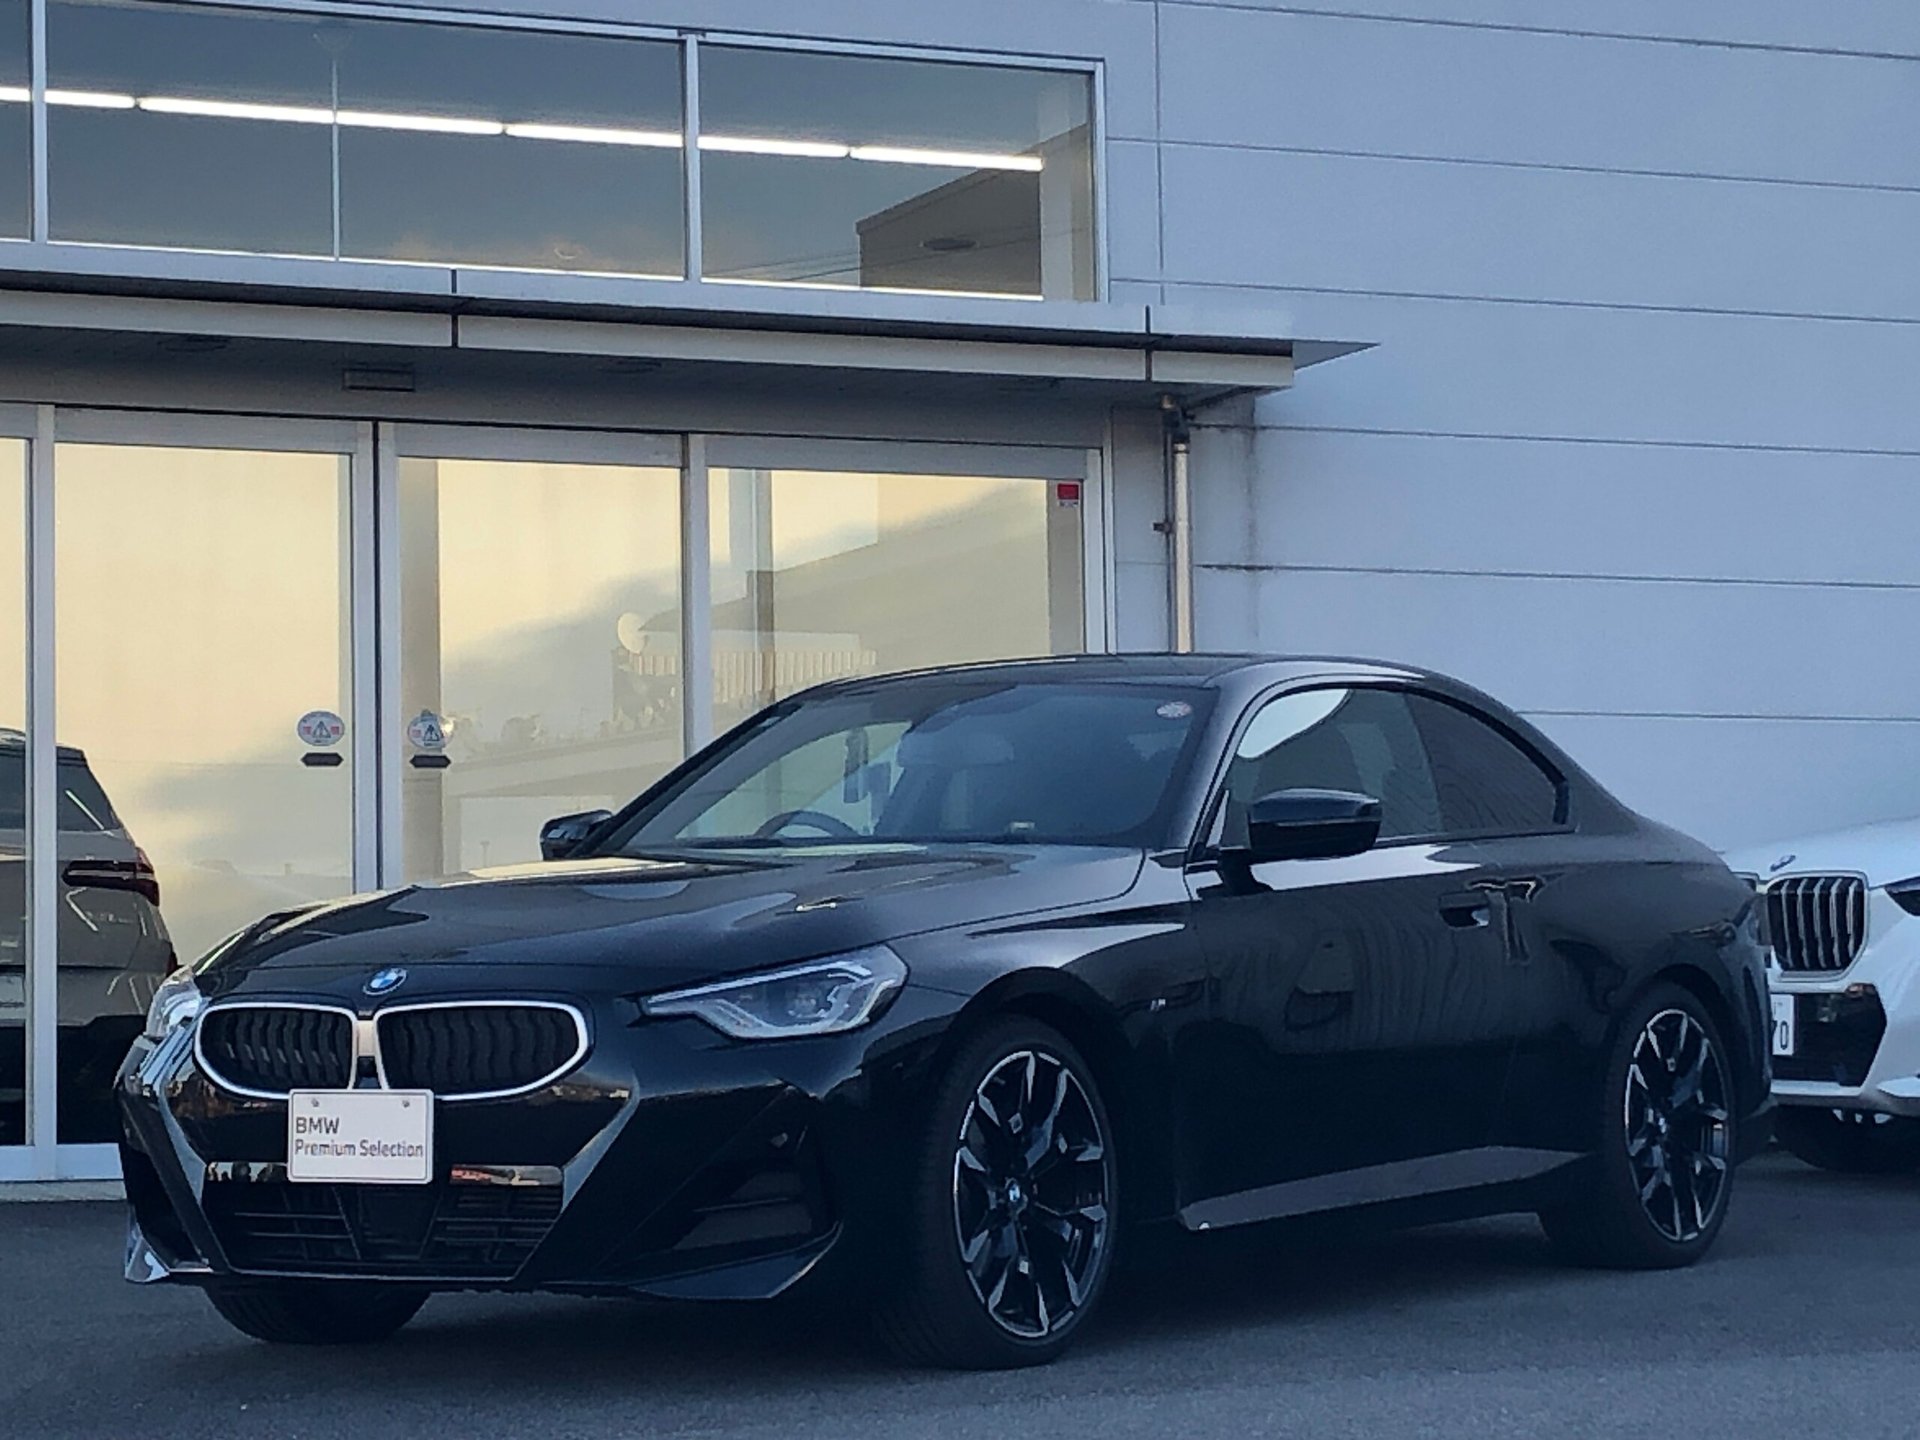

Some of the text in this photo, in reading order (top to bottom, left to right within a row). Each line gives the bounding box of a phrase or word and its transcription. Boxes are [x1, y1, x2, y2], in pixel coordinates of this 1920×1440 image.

[296, 1116, 340, 1134] BMW
[295, 1138, 424, 1157] Premium Selection
